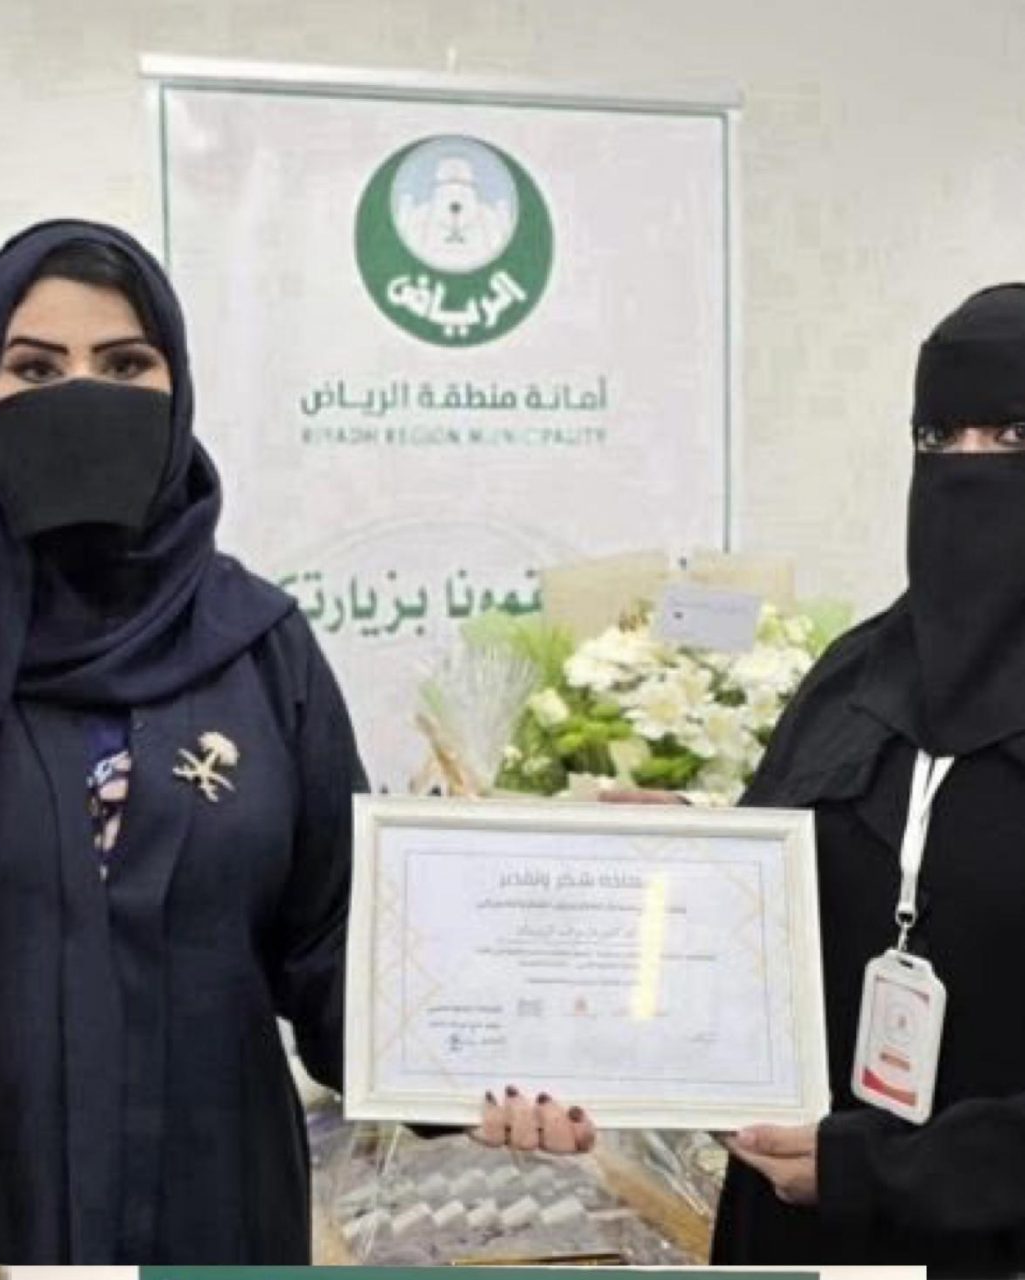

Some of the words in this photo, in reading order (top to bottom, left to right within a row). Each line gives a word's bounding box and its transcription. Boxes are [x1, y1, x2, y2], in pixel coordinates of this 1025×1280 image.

[386, 270, 526, 337] الرياض
[301, 380, 410, 416] الرياض
[417, 380, 517, 410] منطقة
[527, 375, 608, 410] أمانة
